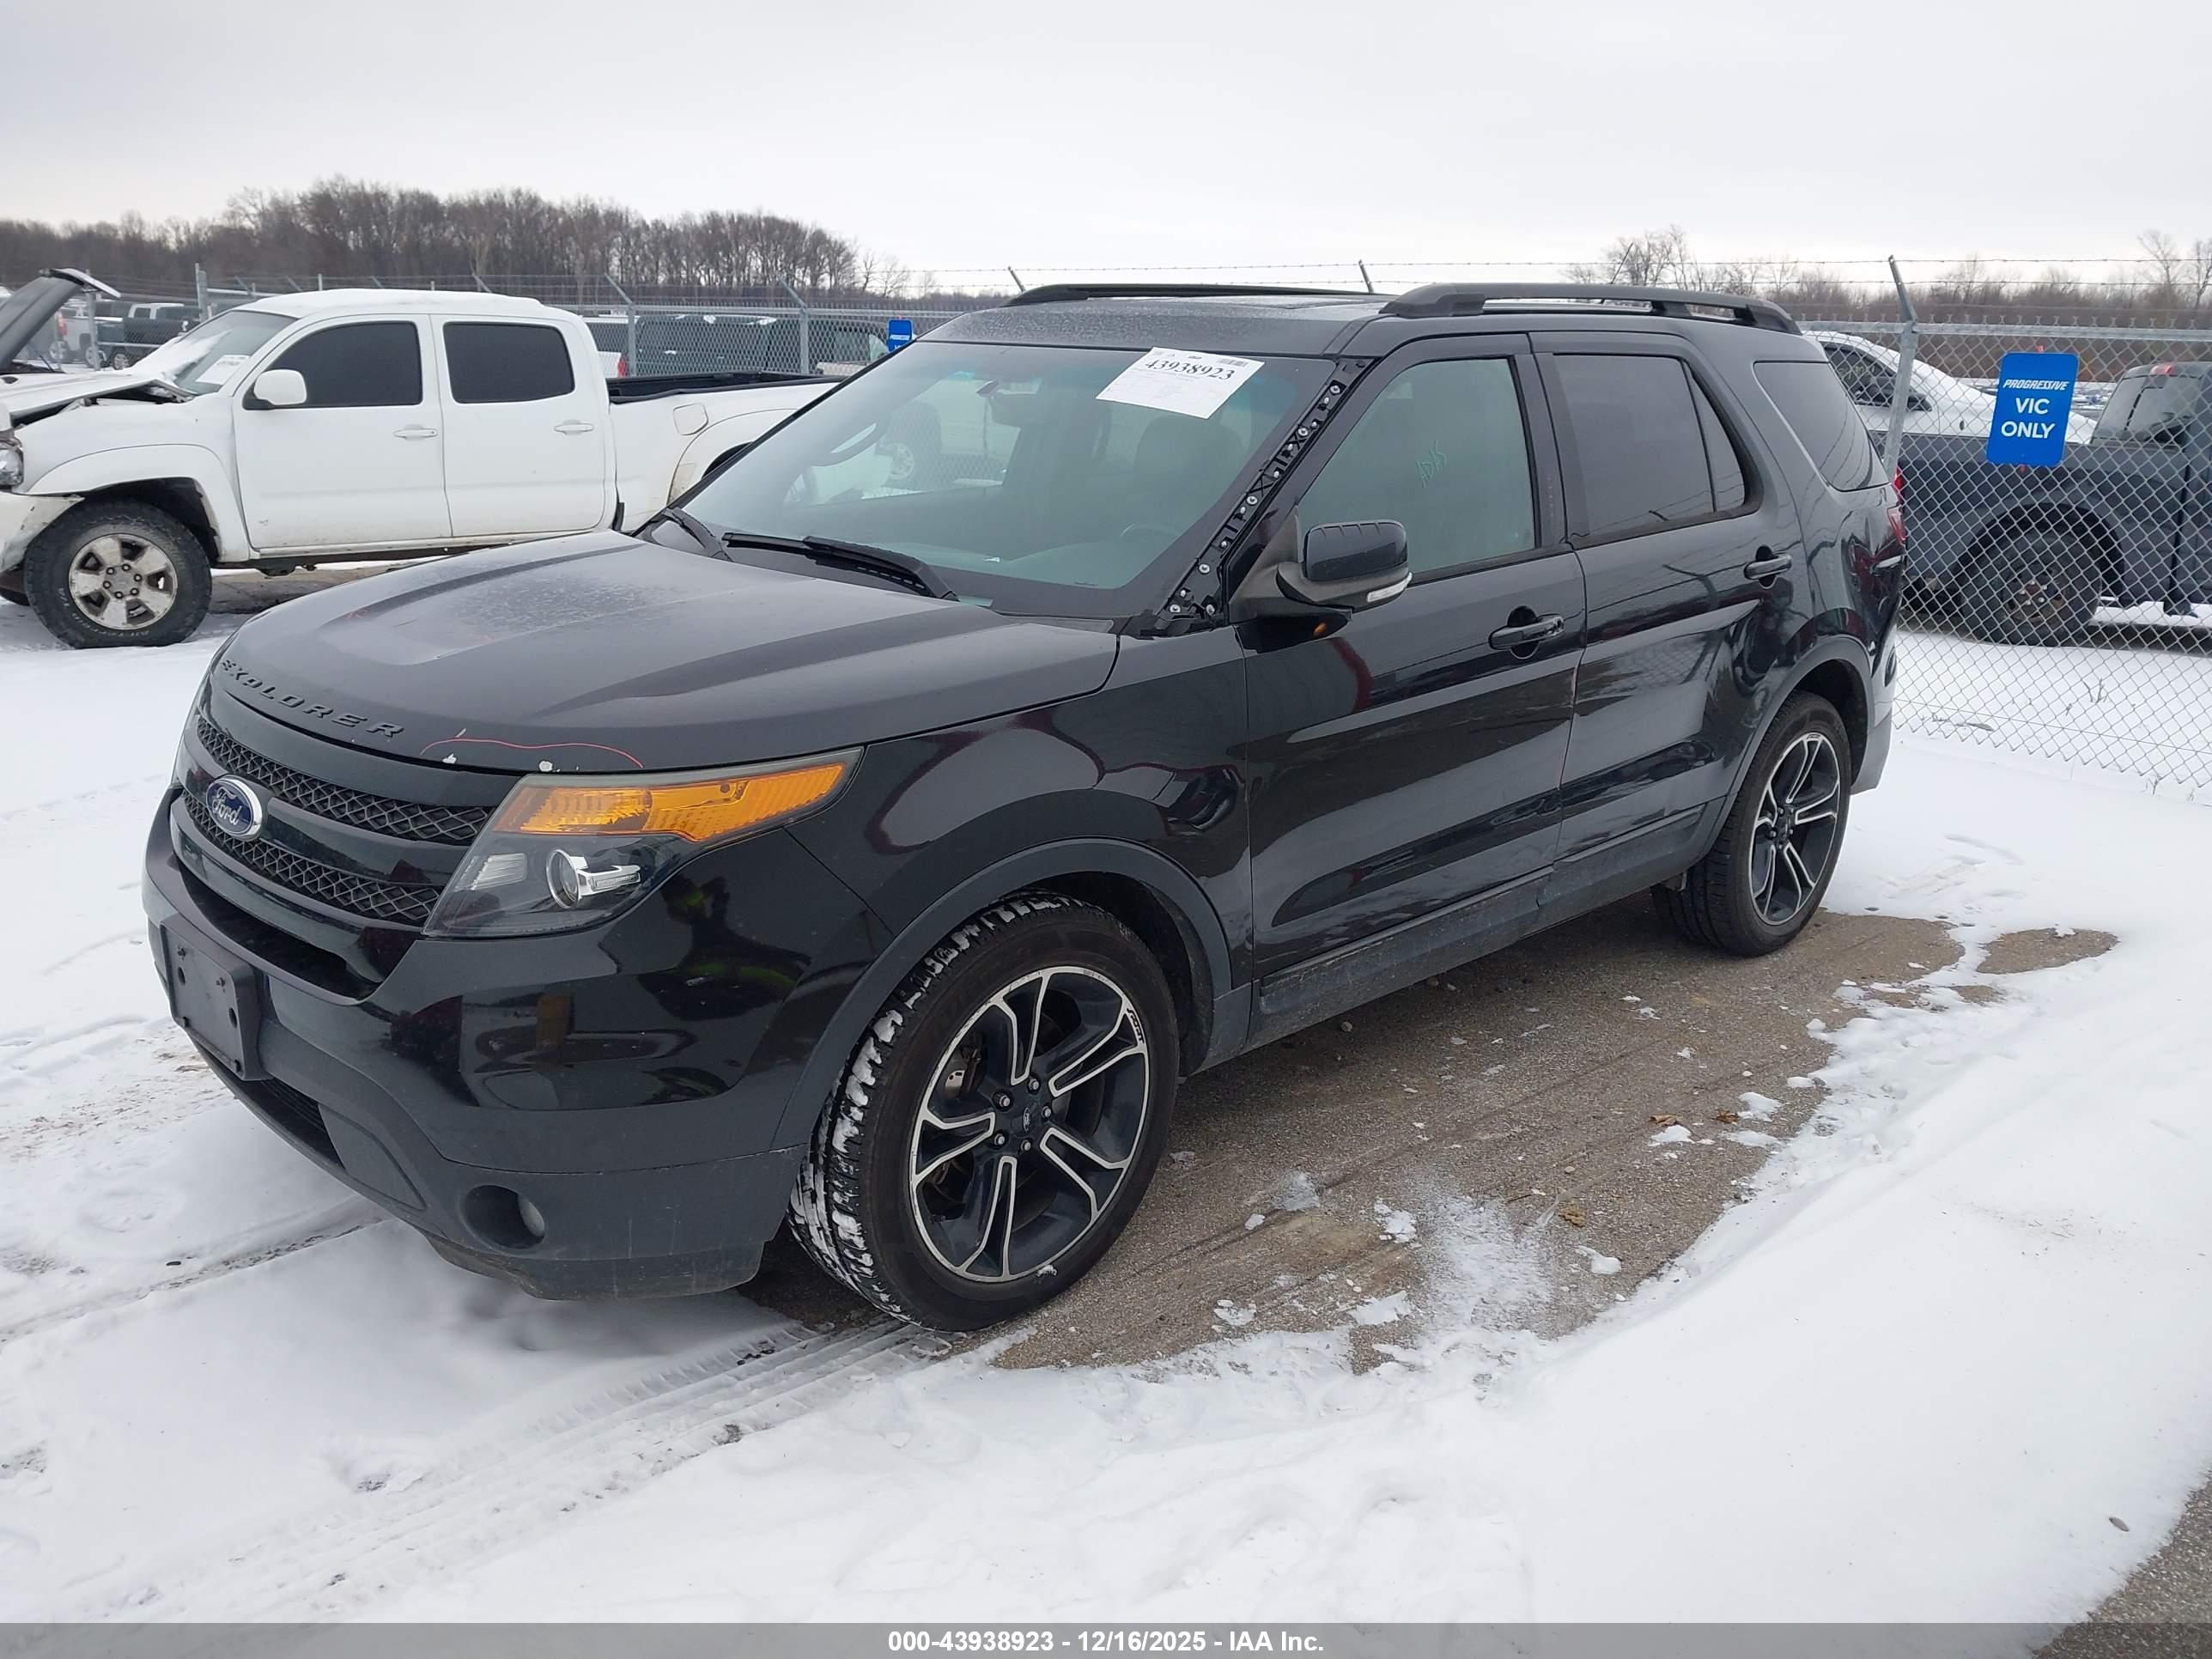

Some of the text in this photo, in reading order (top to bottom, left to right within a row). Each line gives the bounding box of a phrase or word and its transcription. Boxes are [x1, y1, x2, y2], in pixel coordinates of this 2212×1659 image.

[1145, 358, 1236, 380] 43938923
[2002, 379, 2069, 391] PROGRESSIVE
[2014, 397, 2051, 415] VIC
[2001, 420, 2056, 439] ONLY
[211, 786, 242, 825] Ford
[1126, 1007, 1146, 1045] SPORT
